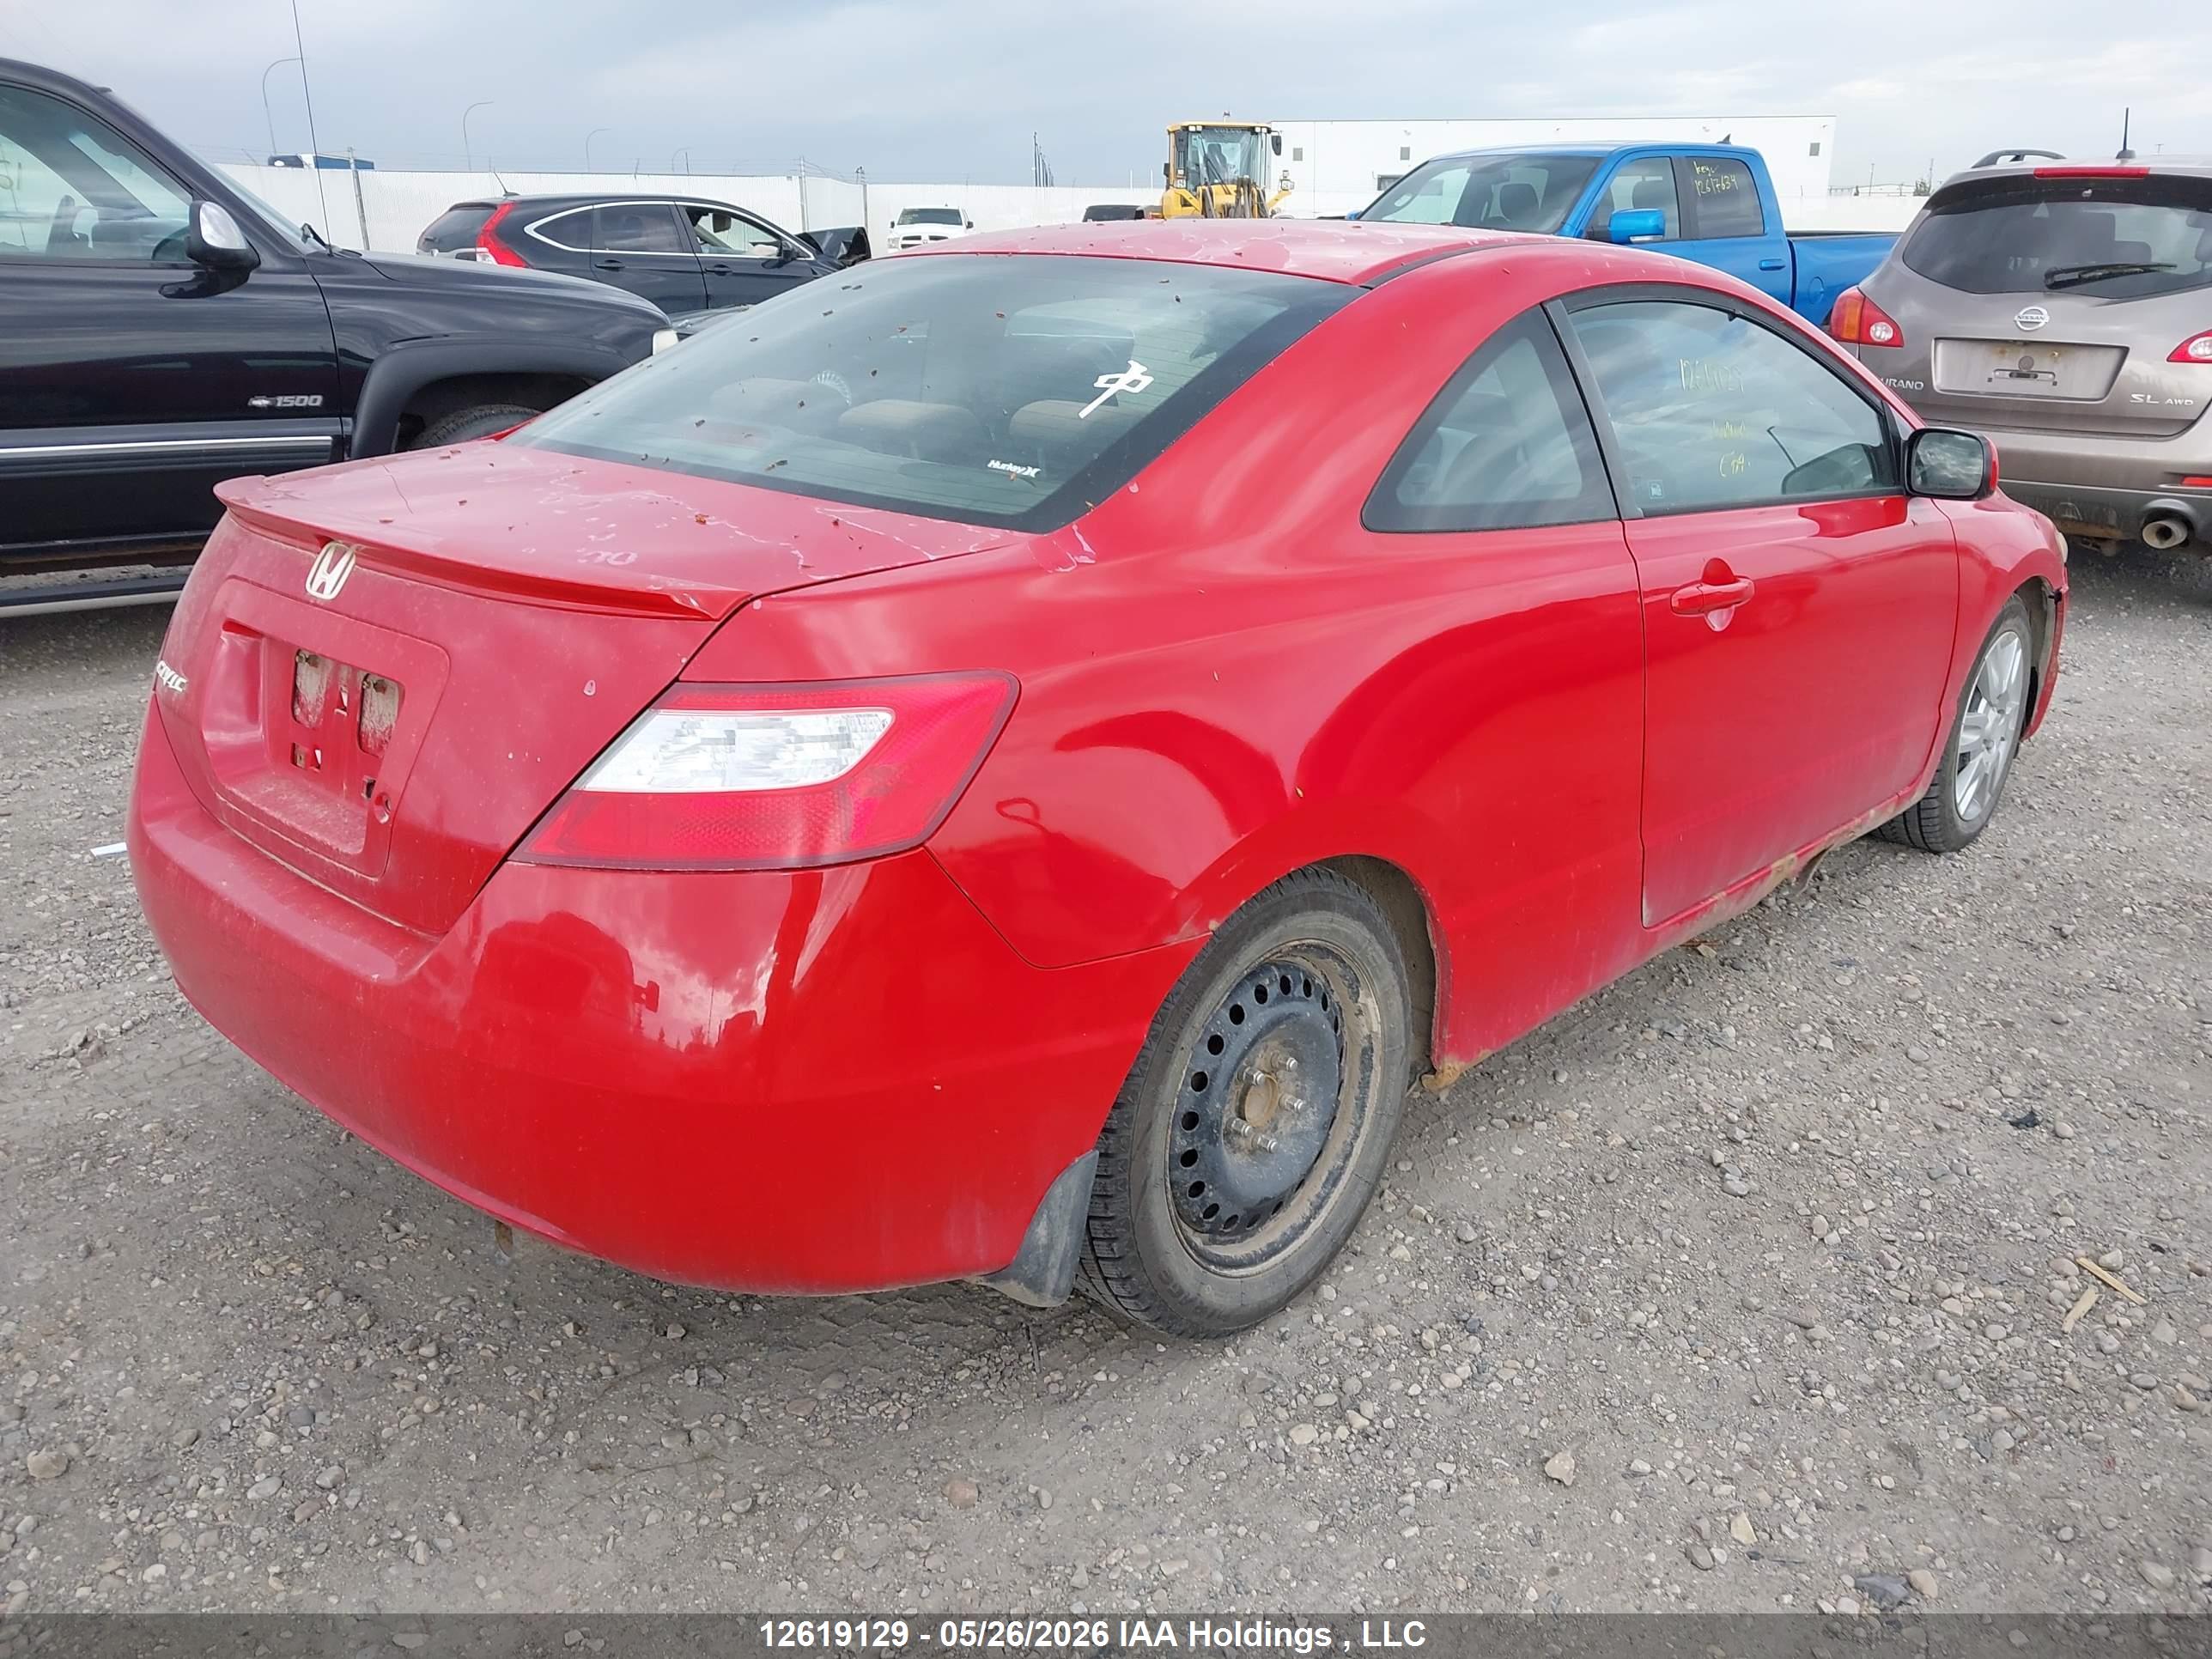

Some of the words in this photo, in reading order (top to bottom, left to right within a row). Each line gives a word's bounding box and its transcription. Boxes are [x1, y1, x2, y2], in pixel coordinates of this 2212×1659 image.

[276, 395, 323, 407] 1500
[2130, 393, 2160, 404] SL
[2165, 398, 2194, 406] AWD
